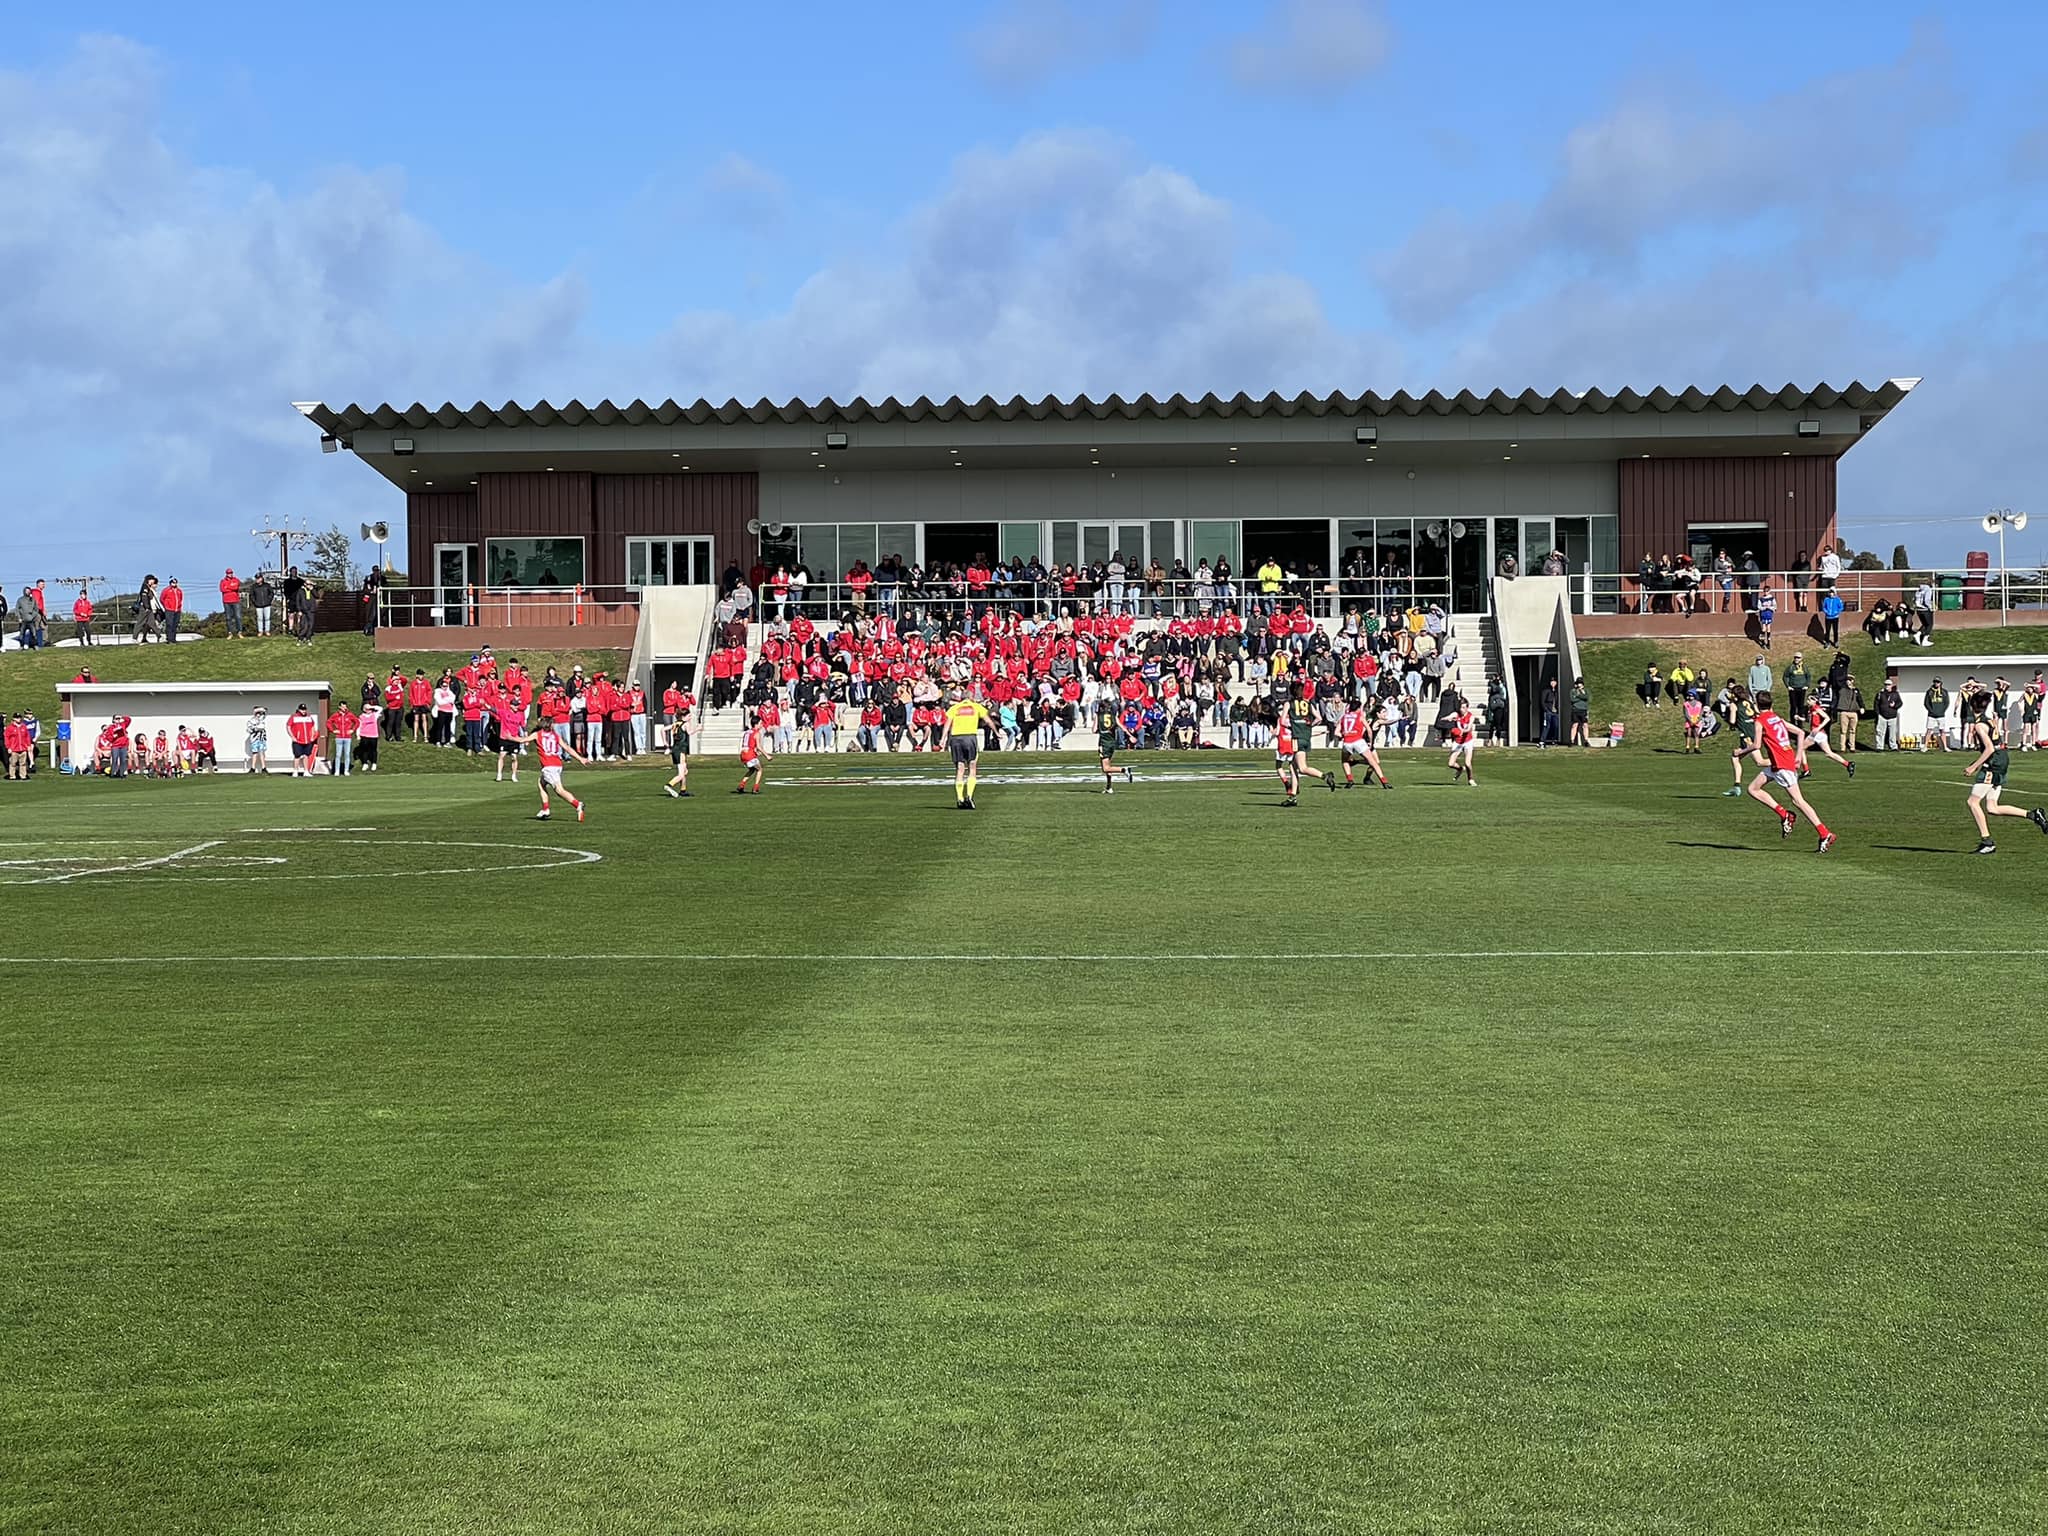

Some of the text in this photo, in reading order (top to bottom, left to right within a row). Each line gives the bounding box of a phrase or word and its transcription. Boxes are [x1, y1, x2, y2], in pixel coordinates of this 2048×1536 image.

[1294, 699, 1309, 716] 19
[1743, 700, 1755, 717] 3
[1104, 714, 1112, 728] 5
[1343, 717, 1355, 731] 17
